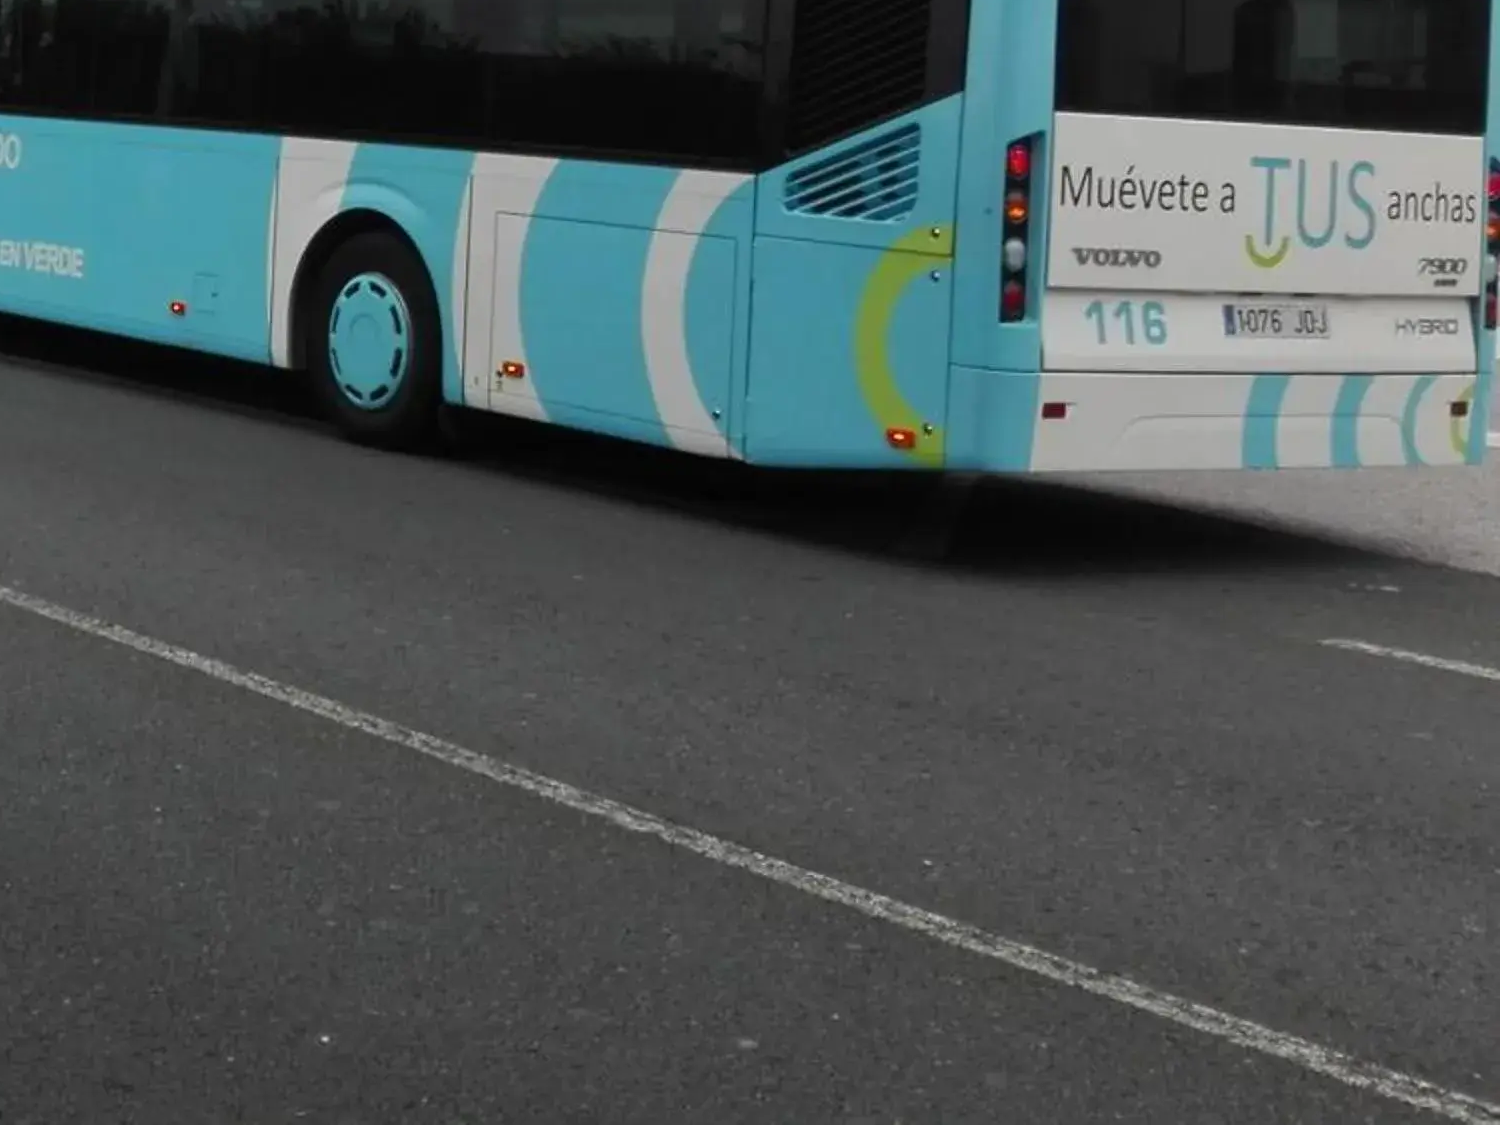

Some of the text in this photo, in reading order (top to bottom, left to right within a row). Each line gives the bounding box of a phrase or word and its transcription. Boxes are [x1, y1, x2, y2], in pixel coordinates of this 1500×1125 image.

[1059, 156, 1477, 250] Muévete a TUS anchas
[0, 239, 21, 268] EN
[23, 241, 85, 278] VERDE
[1071, 246, 1162, 269] VOLVO
[1418, 257, 1468, 276] 7900
[1084, 299, 1168, 346] 116
